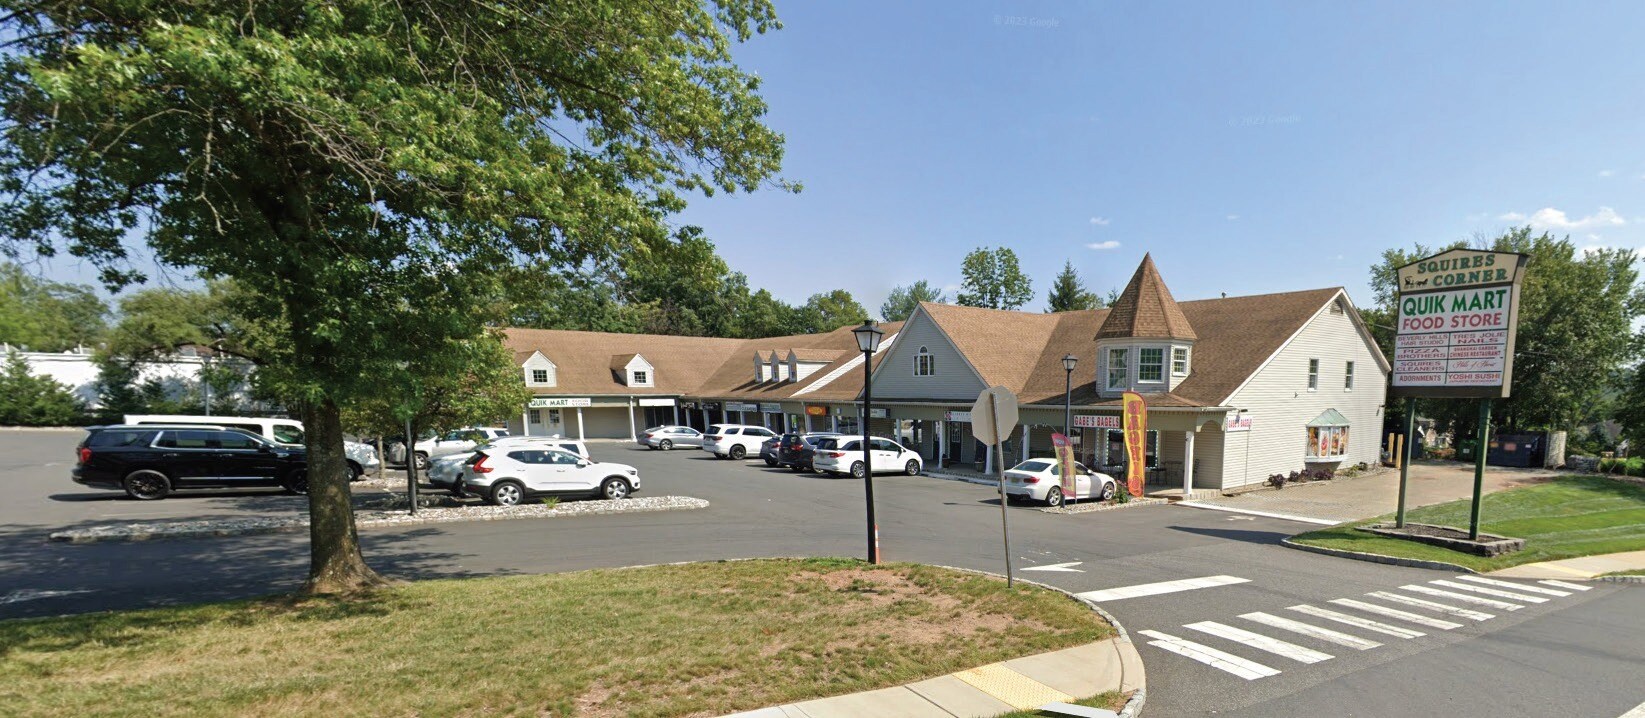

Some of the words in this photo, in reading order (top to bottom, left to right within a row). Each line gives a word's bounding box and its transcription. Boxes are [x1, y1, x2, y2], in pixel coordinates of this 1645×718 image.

[1417, 254, 1496, 274] SQUIRES
[1432, 268, 1508, 287] CORNER
[1402, 294, 1447, 316] QUIK
[1451, 289, 1508, 313] MART
[1402, 316, 1445, 331] FOOD
[1450, 312, 1502, 328] STORE
[1074, 416, 1095, 426] GABE'S
[1096, 416, 1119, 427] BAGELS
